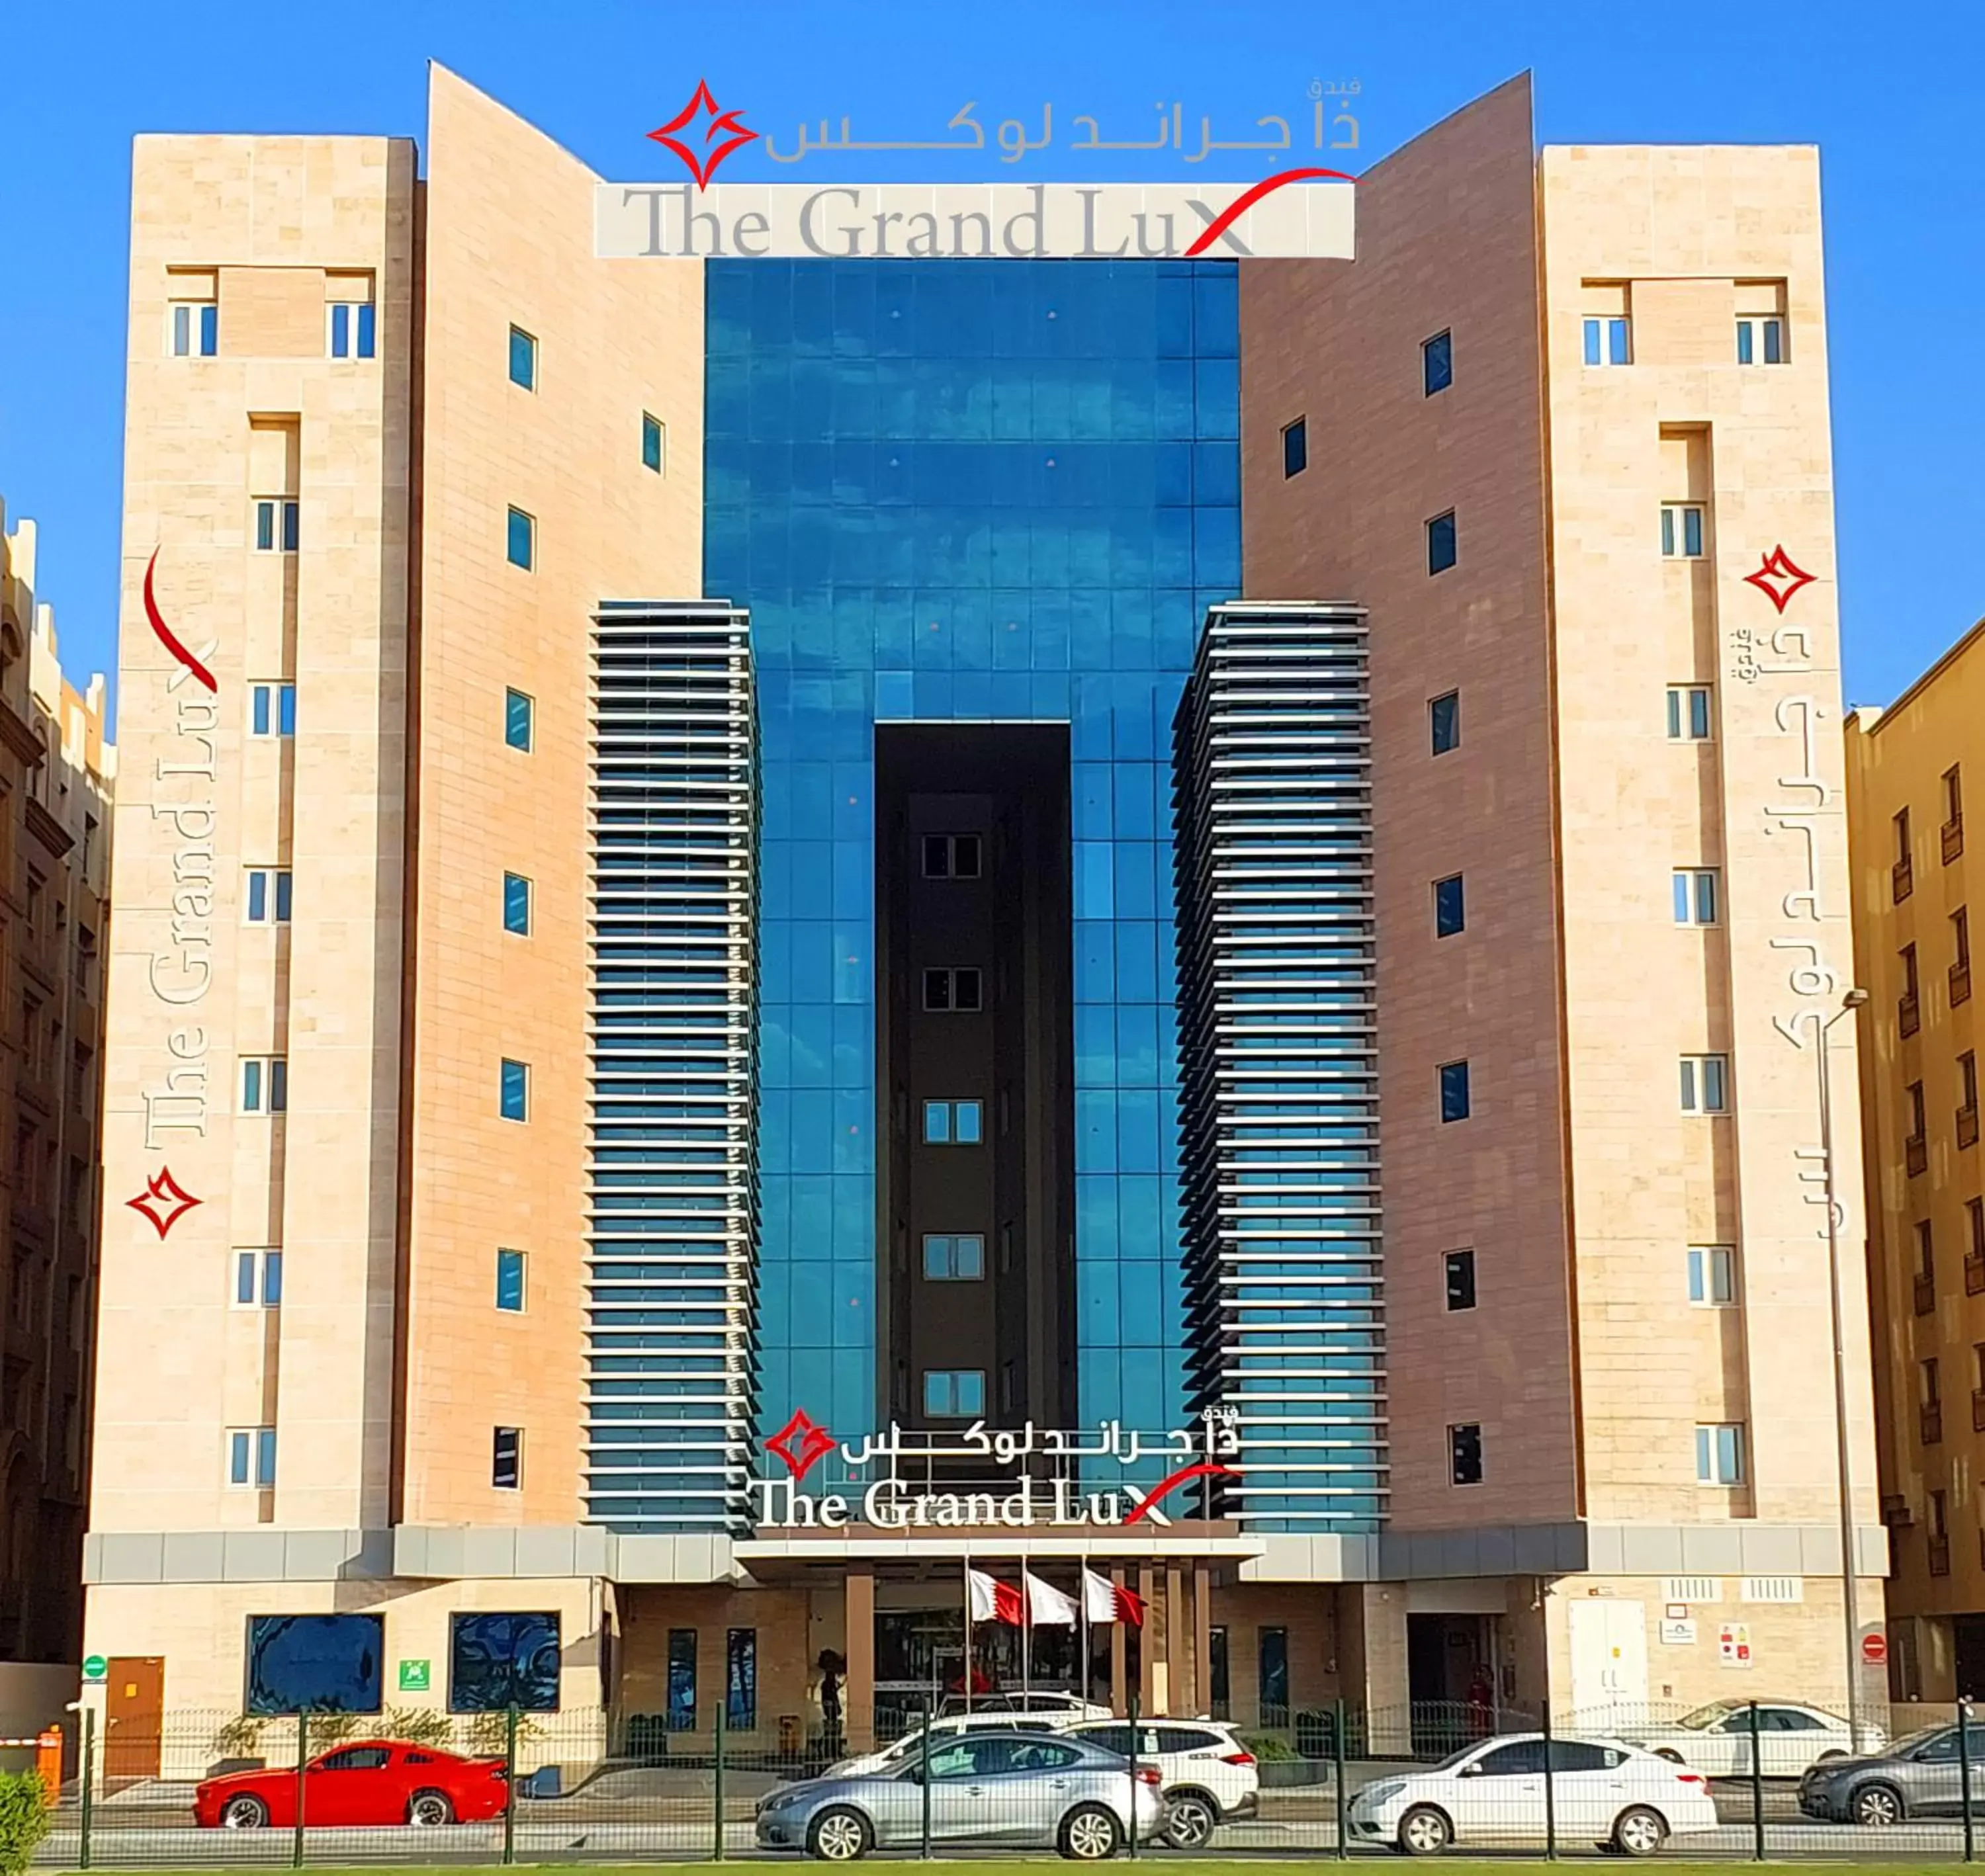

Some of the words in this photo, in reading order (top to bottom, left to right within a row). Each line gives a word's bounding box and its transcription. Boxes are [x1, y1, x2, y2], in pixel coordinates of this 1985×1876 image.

[1306, 77, 1362, 100] فندق
[766, 101, 1052, 163] لوكس
[1070, 103, 1292, 163] جراند
[1314, 100, 1360, 149] ذا
[623, 184, 771, 257] The
[799, 184, 1054, 257] Grand
[1730, 628, 1758, 685] فندق
[1756, 624, 1812, 674] ذا
[1764, 695, 1831, 922] جراند
[150, 800, 217, 1005] Grand
[142, 1027, 210, 1150] The
[1201, 1404, 1239, 1421] فندق
[1206, 1416, 1239, 1455] ذا
[841, 1420, 1034, 1465] لوكس
[1043, 1419, 1192, 1463] جراند
[746, 1475, 848, 1528] The
[864, 1475, 1037, 1528] Grand
